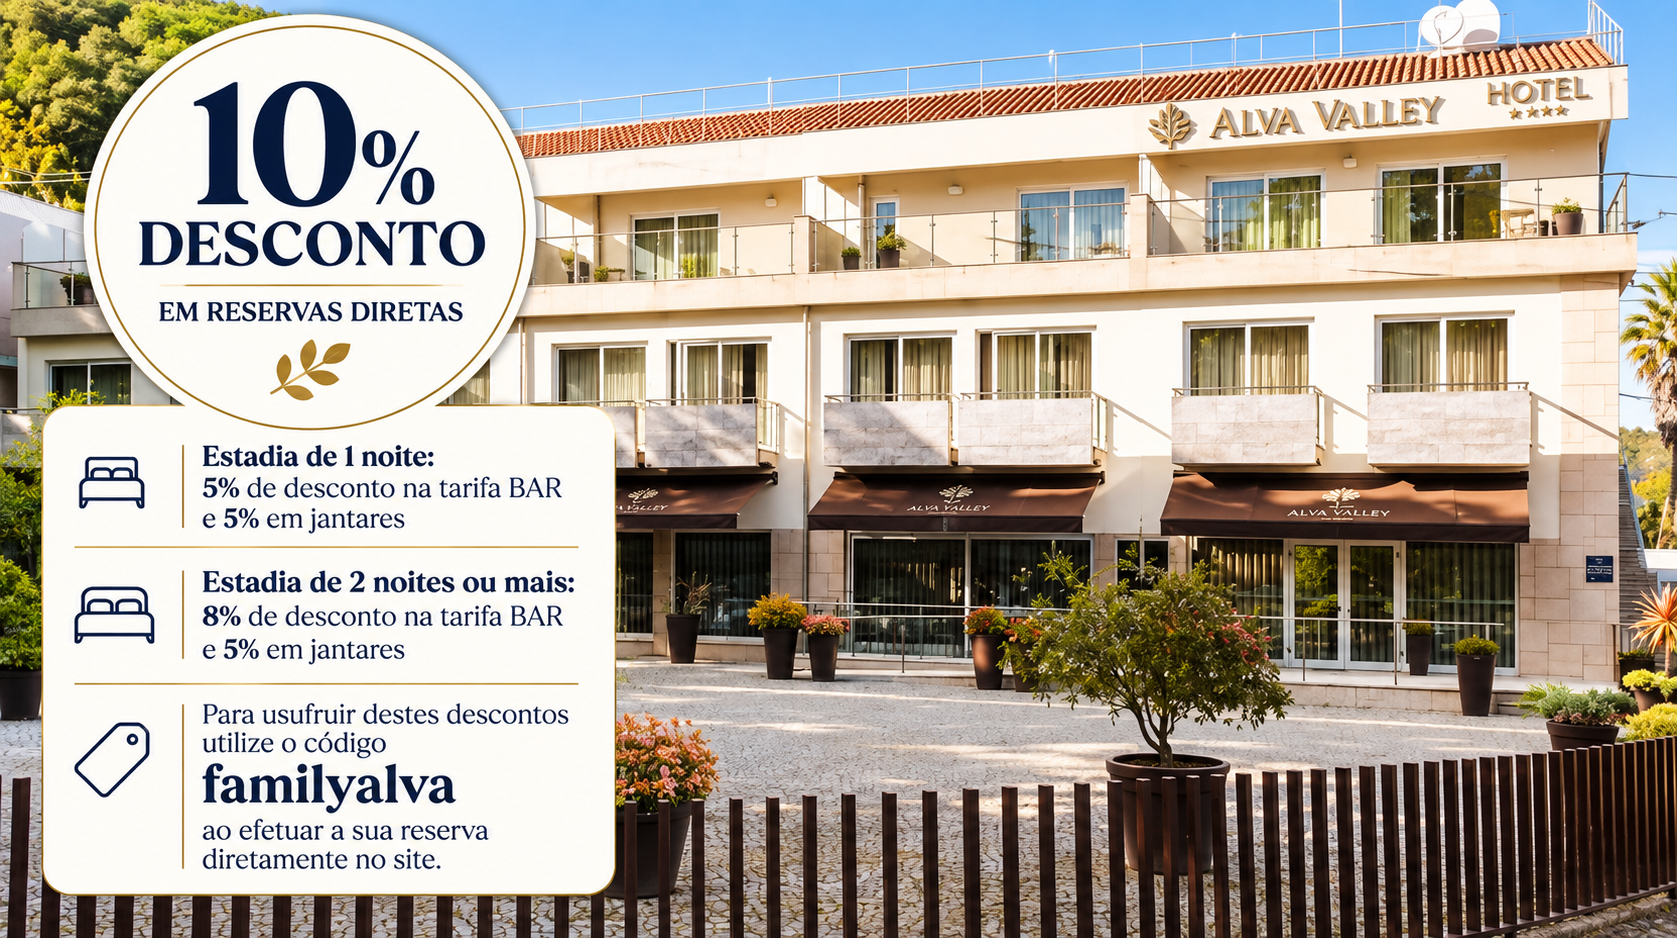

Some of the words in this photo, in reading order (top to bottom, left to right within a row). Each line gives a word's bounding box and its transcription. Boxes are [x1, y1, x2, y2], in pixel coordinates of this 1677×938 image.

[1486, 76, 1590, 106] HOTEL
[1209, 106, 1300, 139] ALVA
[1312, 95, 1441, 132] VALLEY
[906, 504, 939, 512] ALVA
[944, 504, 991, 512] VALLEY
[1287, 509, 1327, 517] ALVA
[1333, 509, 1390, 517] VALLEY
